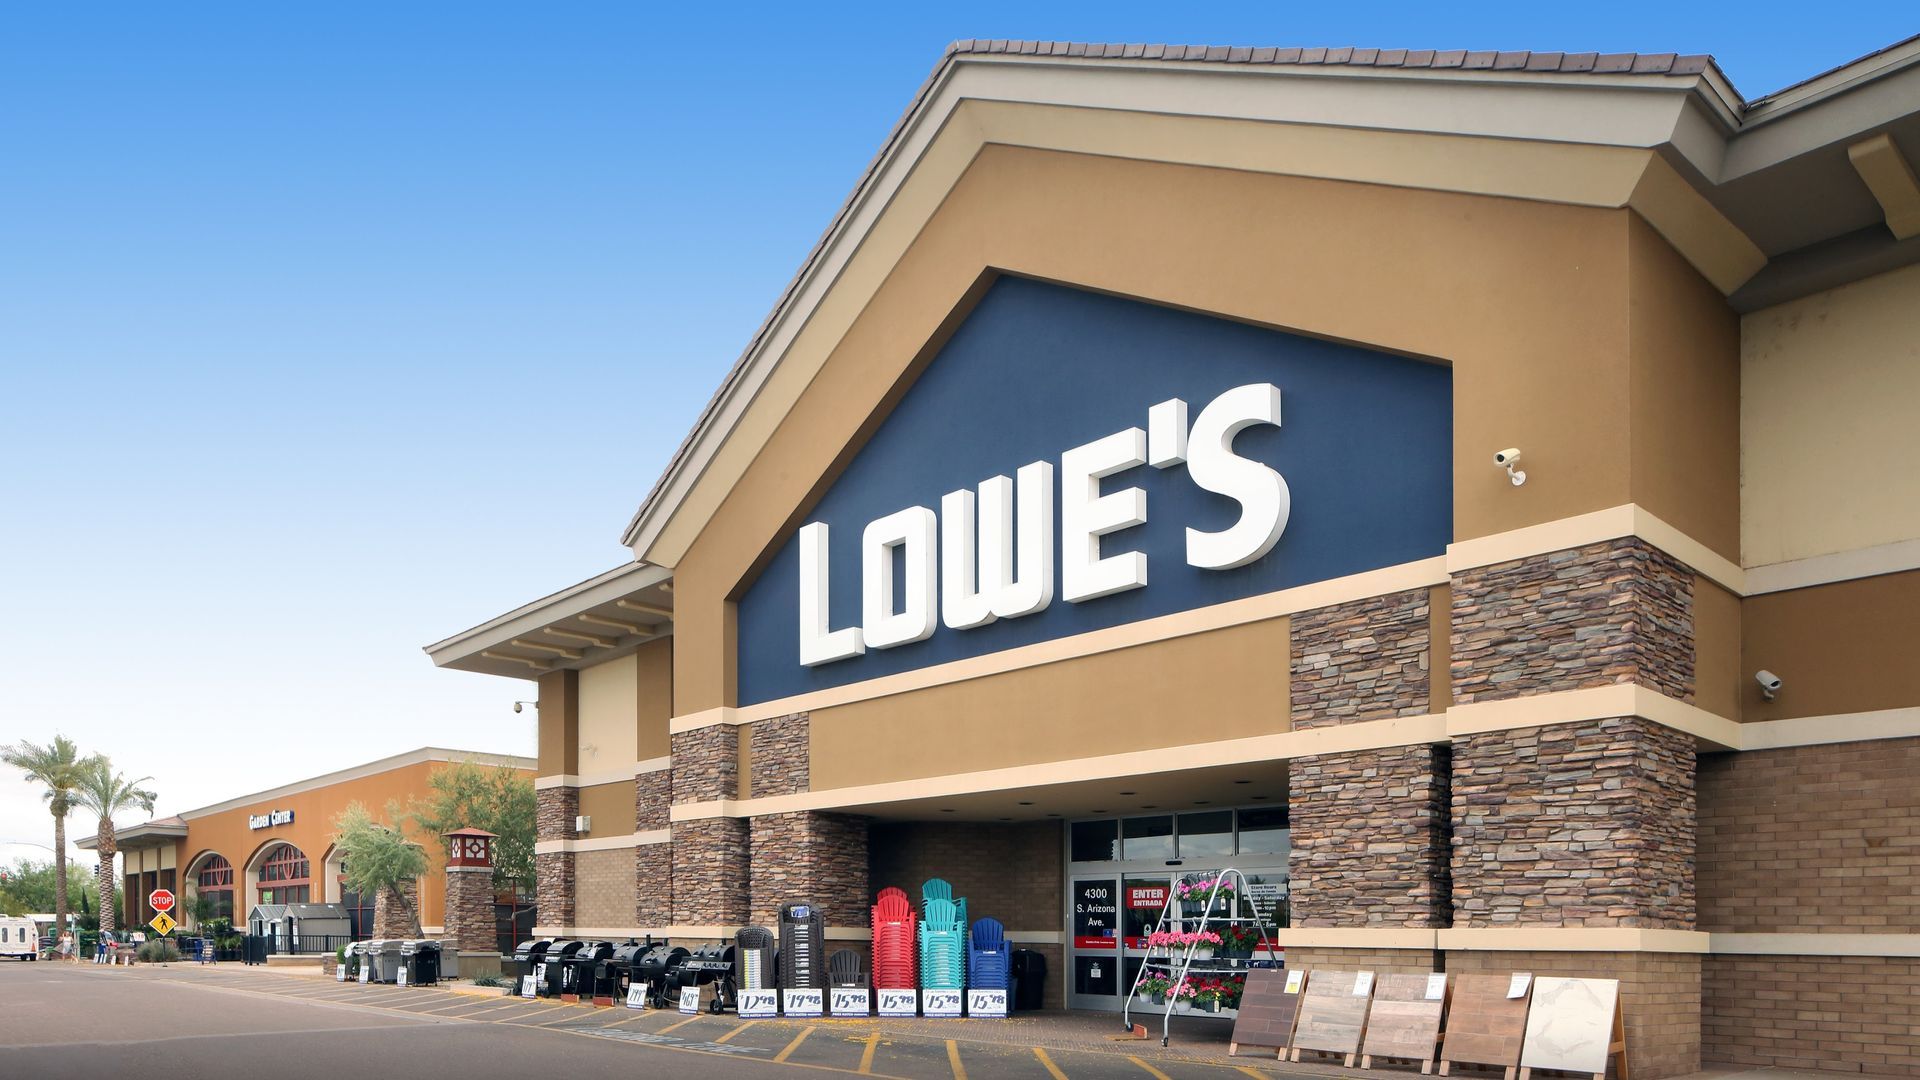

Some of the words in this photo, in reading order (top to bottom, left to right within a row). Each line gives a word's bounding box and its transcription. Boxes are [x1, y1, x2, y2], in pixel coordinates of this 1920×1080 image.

[799, 382, 1291, 666] LOWE'S
[1084, 888, 1108, 899] 4300
[1132, 889, 1164, 899] ENTER
[152, 896, 172, 905] STOP
[1076, 904, 1085, 913] S.
[1087, 904, 1116, 913] Arizona
[1087, 917, 1105, 927] Ave.
